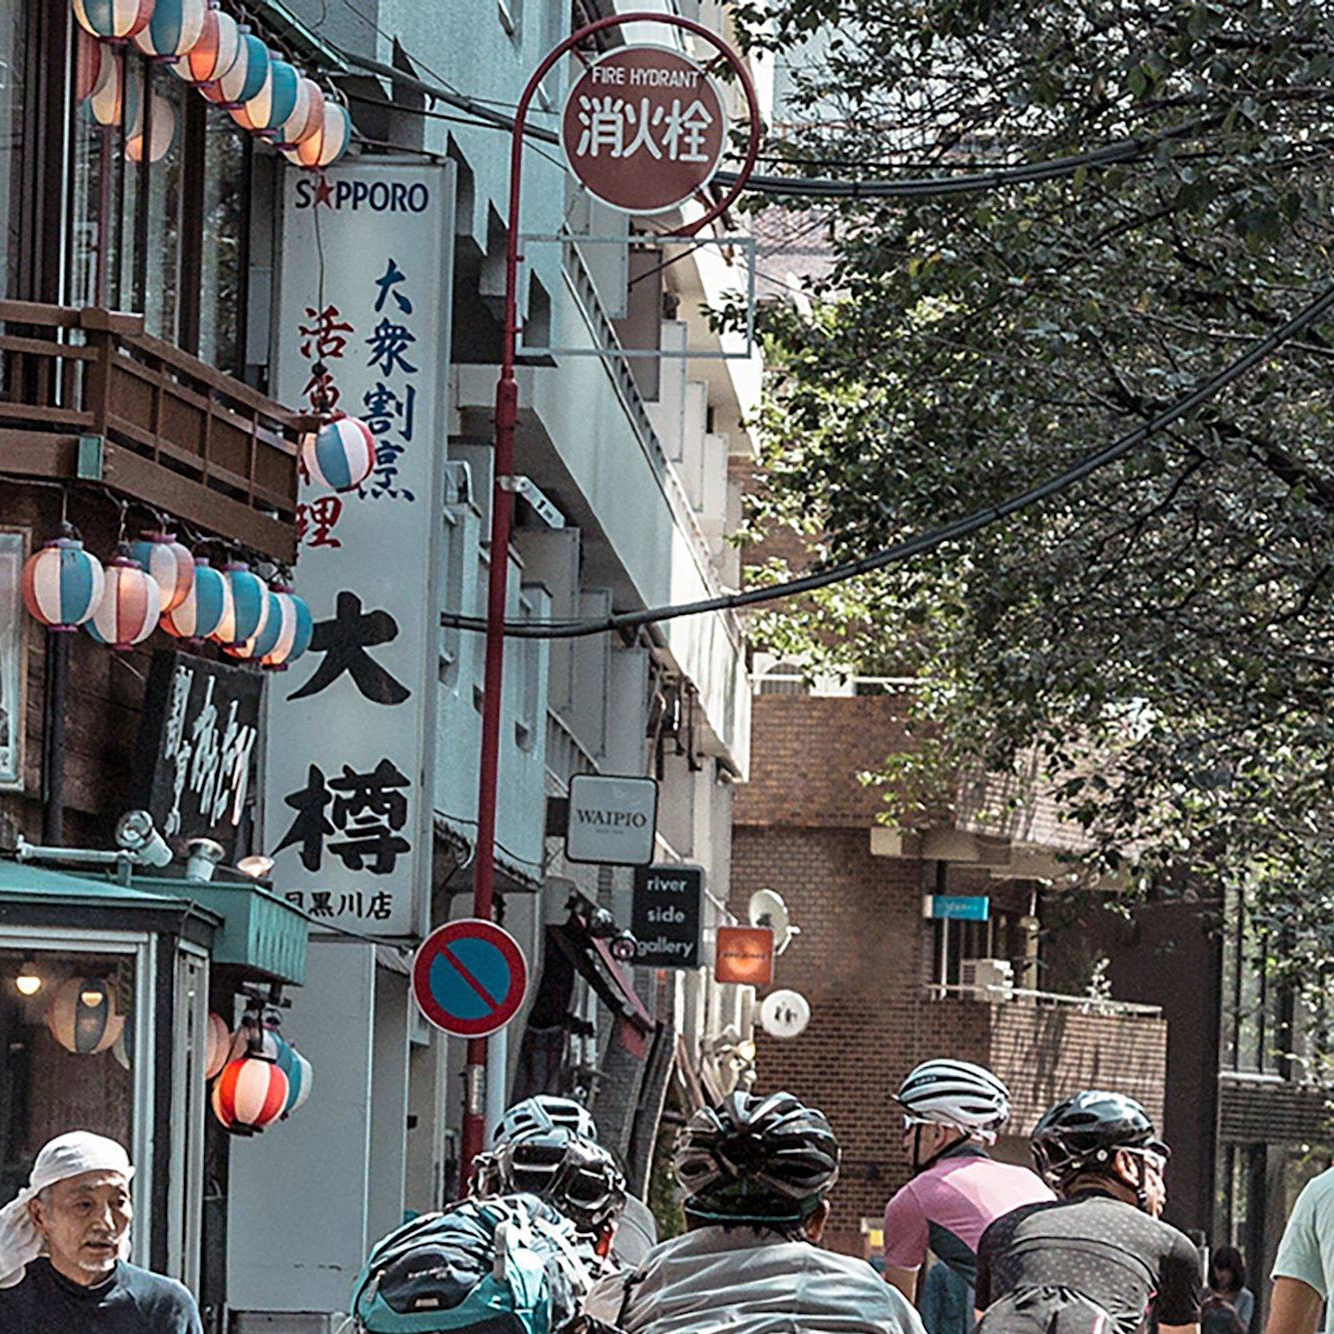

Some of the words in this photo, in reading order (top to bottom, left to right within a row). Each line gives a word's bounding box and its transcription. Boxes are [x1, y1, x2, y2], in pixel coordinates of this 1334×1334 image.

[592, 66, 625, 85] FIRE
[630, 68, 699, 88] HYDRANT
[576, 95, 713, 162] 消火栓
[359, 258, 418, 502] 大衆割烹
[297, 305, 354, 548] 活魚理
[270, 591, 411, 874] 大樽
[576, 809, 647, 828] WAIPIO
[647, 876, 688, 893] river
[647, 906, 685, 923] side
[637, 940, 694, 957] gallery
